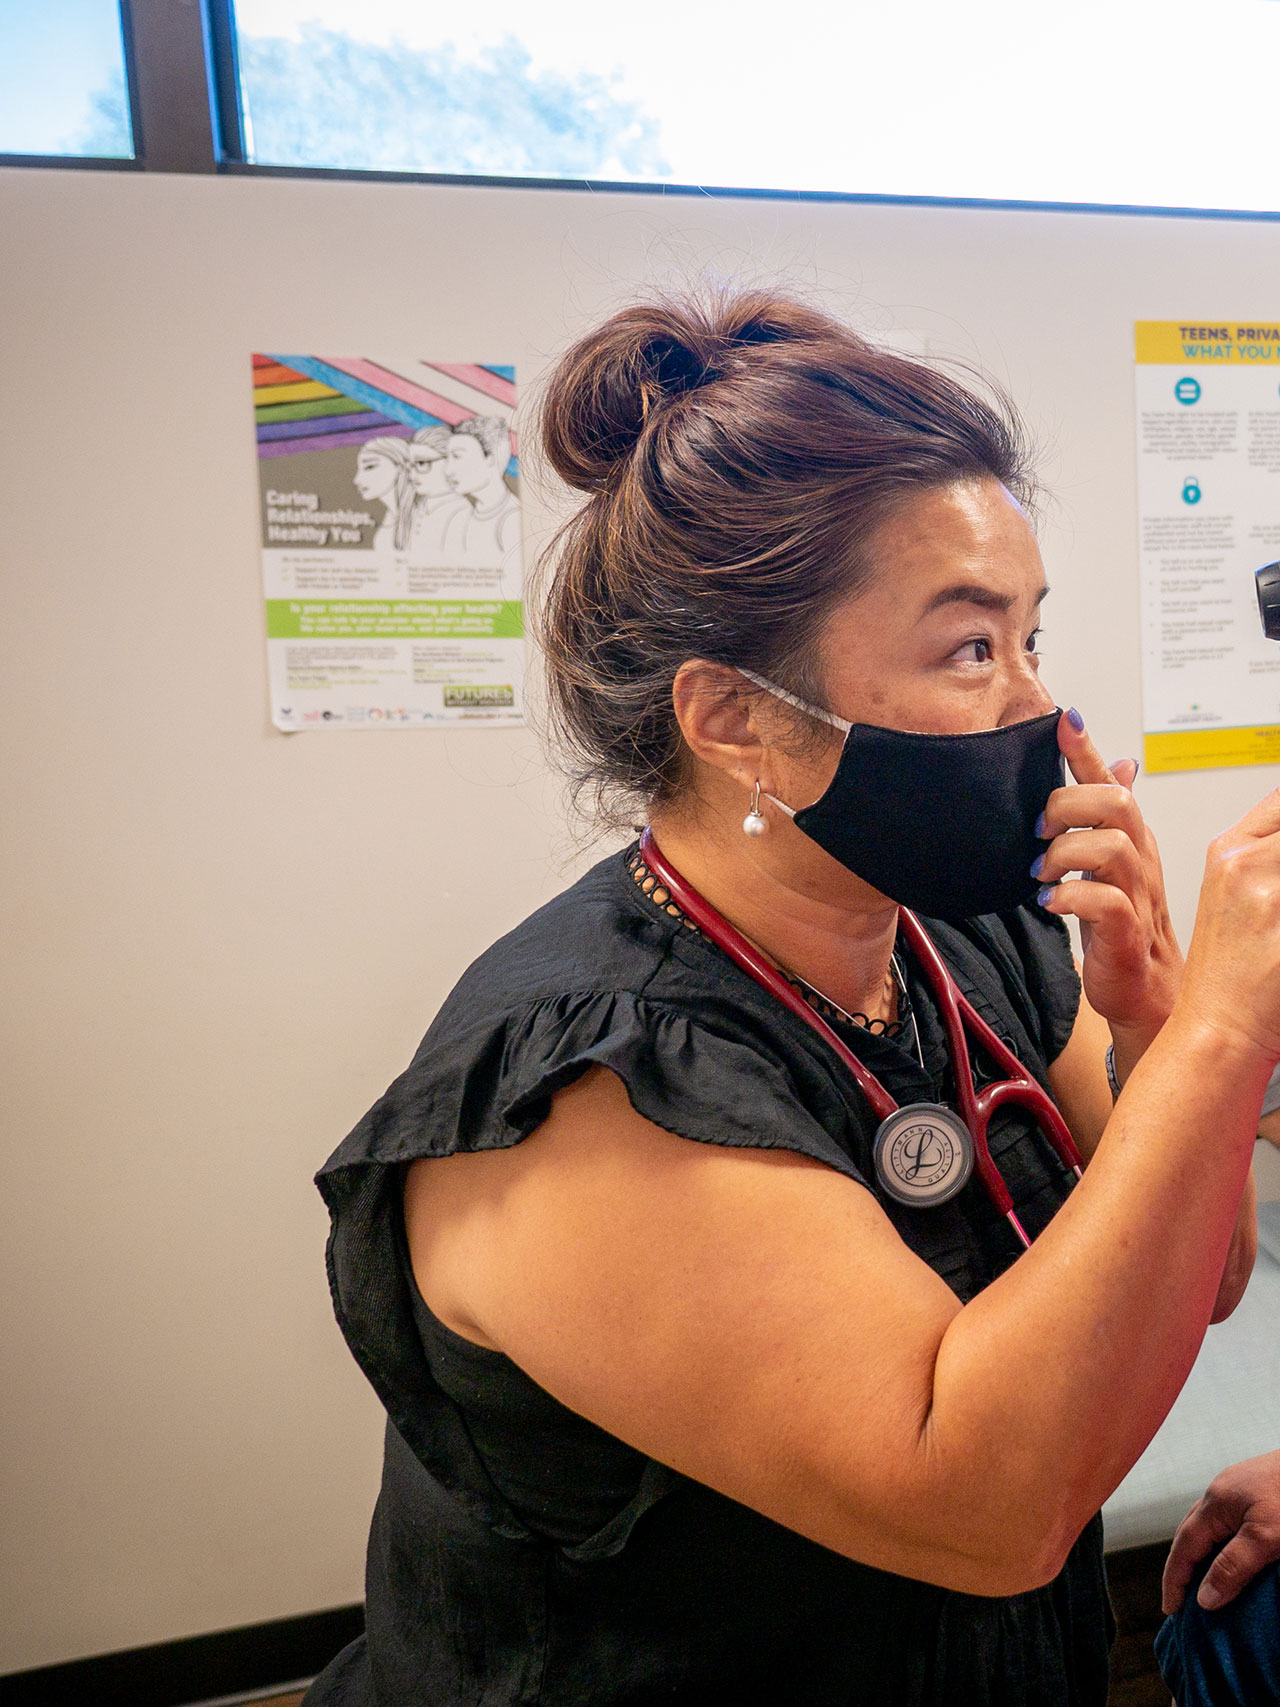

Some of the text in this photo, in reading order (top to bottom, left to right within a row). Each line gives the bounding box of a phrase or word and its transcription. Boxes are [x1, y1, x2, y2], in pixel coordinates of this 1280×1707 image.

[1179, 327, 1232, 341] TEENS,
[1182, 344, 1233, 358] WHAT
[1237, 345, 1272, 359] YOU
[268, 526, 361, 545] Healthy You
[445, 687, 513, 699] FUTURES
